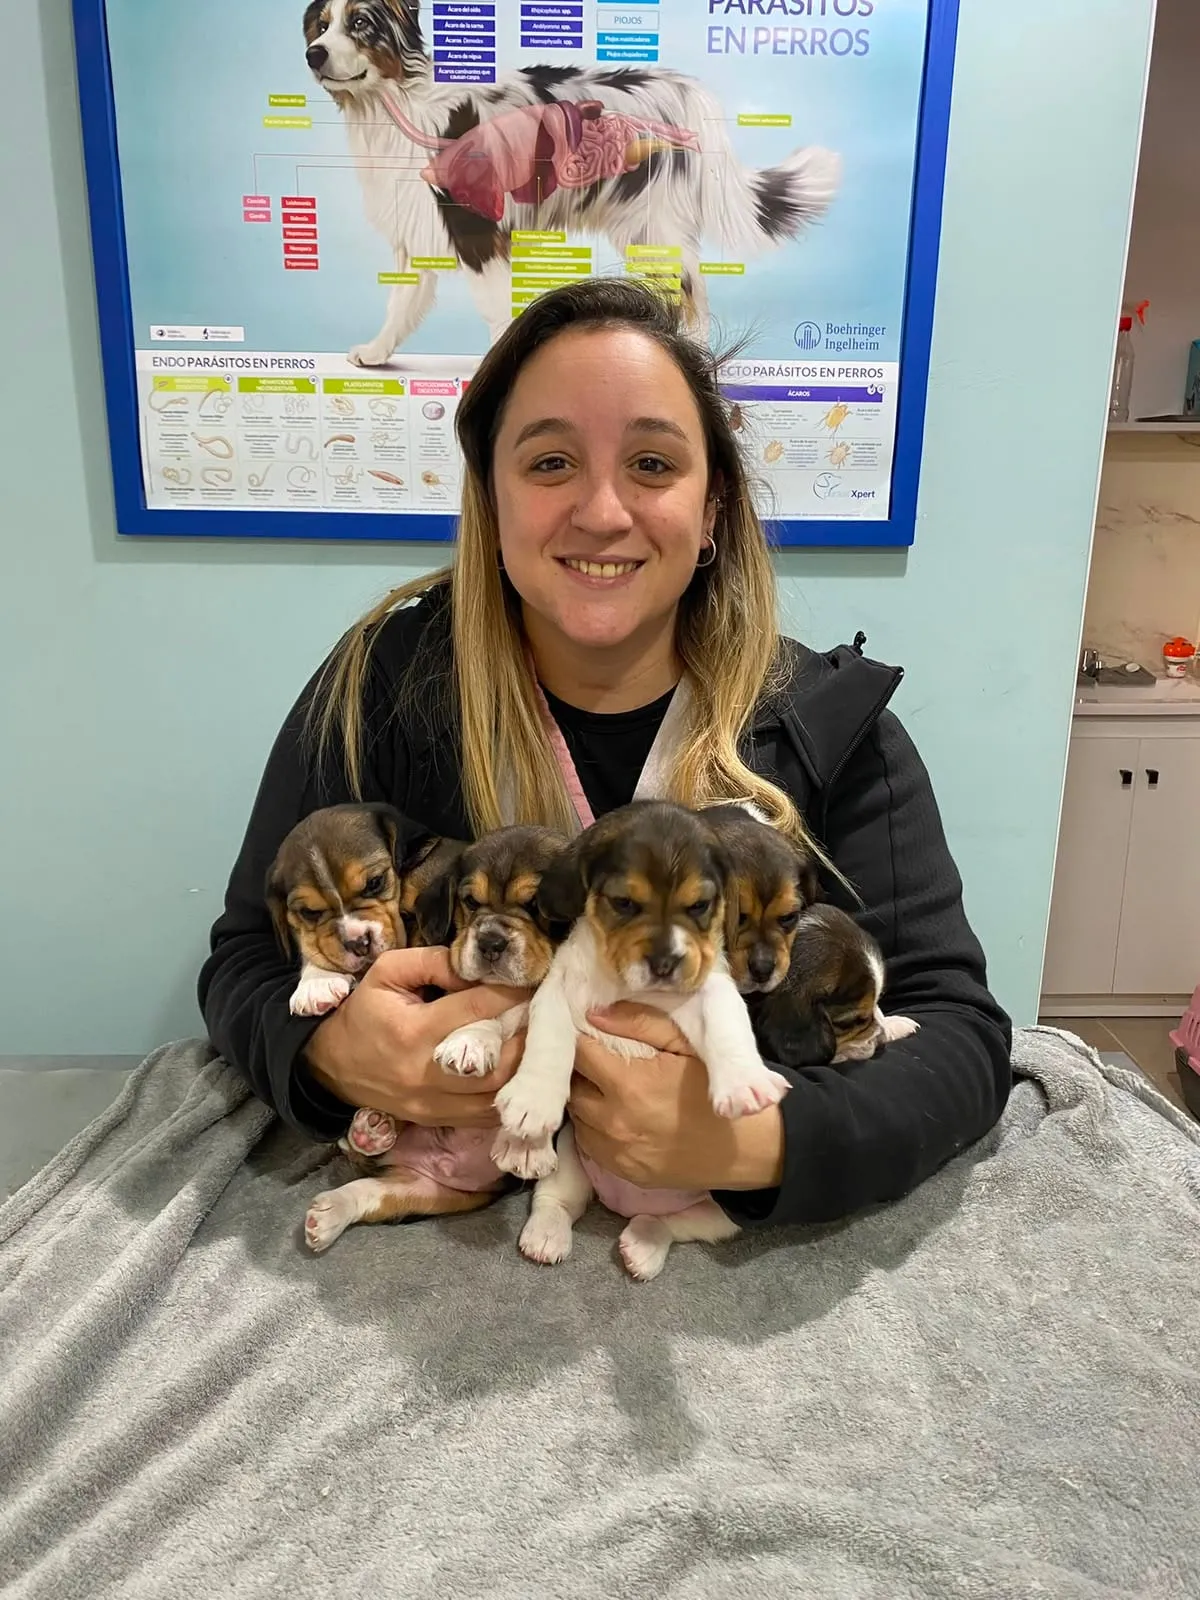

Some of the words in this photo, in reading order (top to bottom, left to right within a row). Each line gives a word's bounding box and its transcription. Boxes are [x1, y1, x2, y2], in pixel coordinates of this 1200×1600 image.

[614, 16, 642, 25] PIOJOS
[707, 25, 746, 54] EN
[753, 26, 870, 57] PERROS
[825, 323, 887, 337] Boehringer
[825, 338, 880, 352] Ingelheim
[253, 358, 268, 369] EN
[270, 358, 315, 370] PERROS
[820, 367, 836, 378] EN
[838, 367, 884, 379] PERROS
